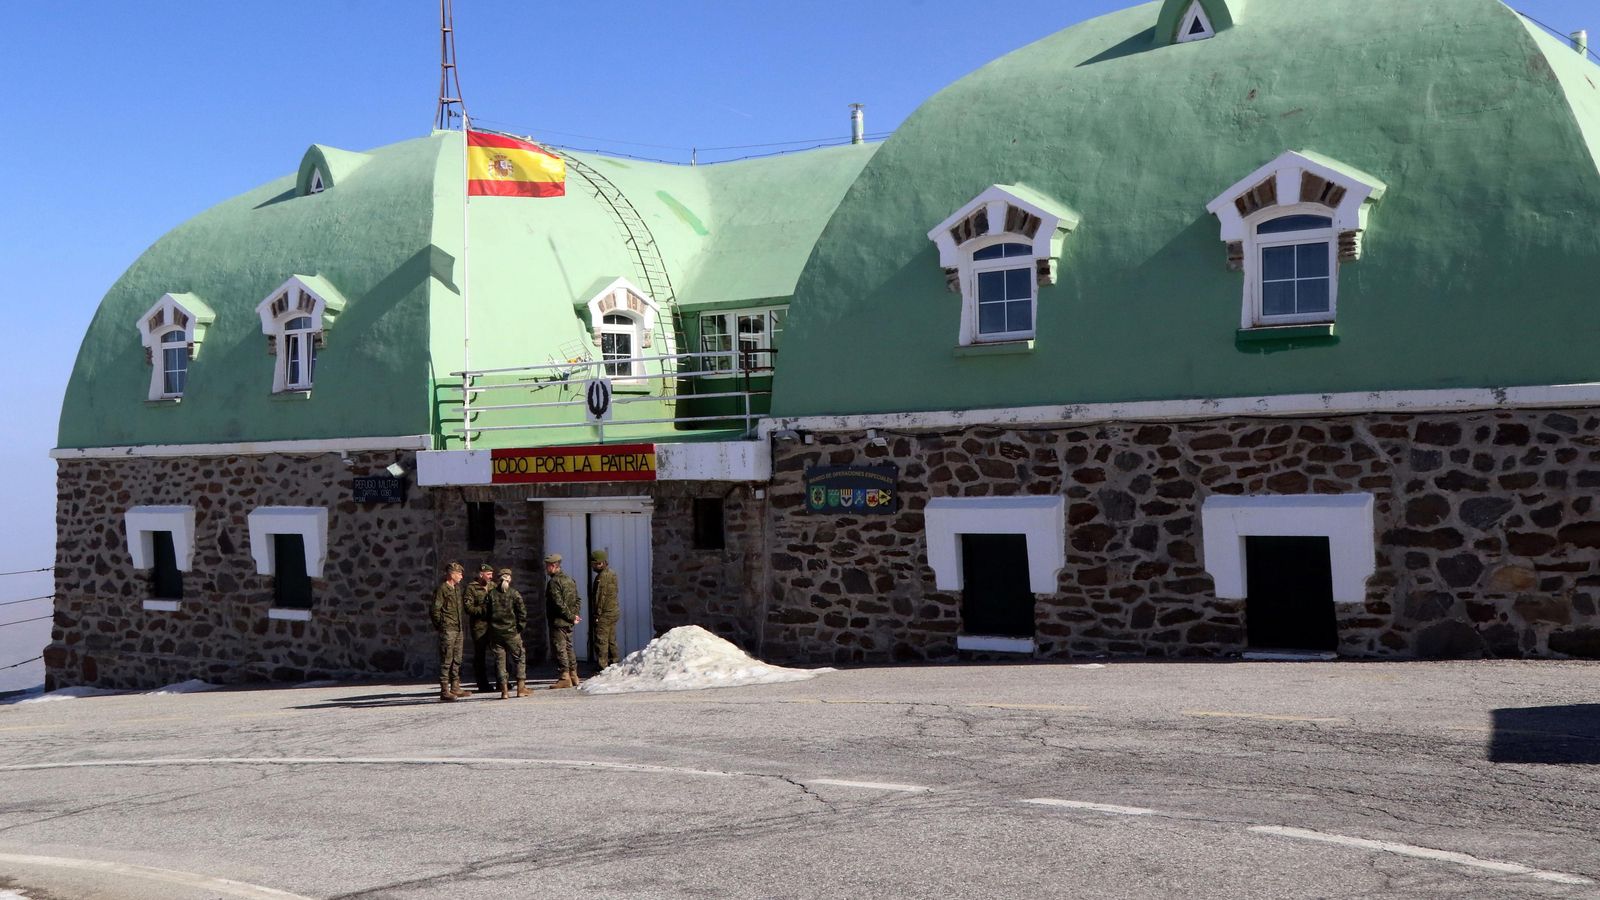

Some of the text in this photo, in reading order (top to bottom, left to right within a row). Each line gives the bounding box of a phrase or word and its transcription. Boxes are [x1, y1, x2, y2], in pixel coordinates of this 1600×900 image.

[490, 453, 650, 473] TODO POR LA PATRIA
